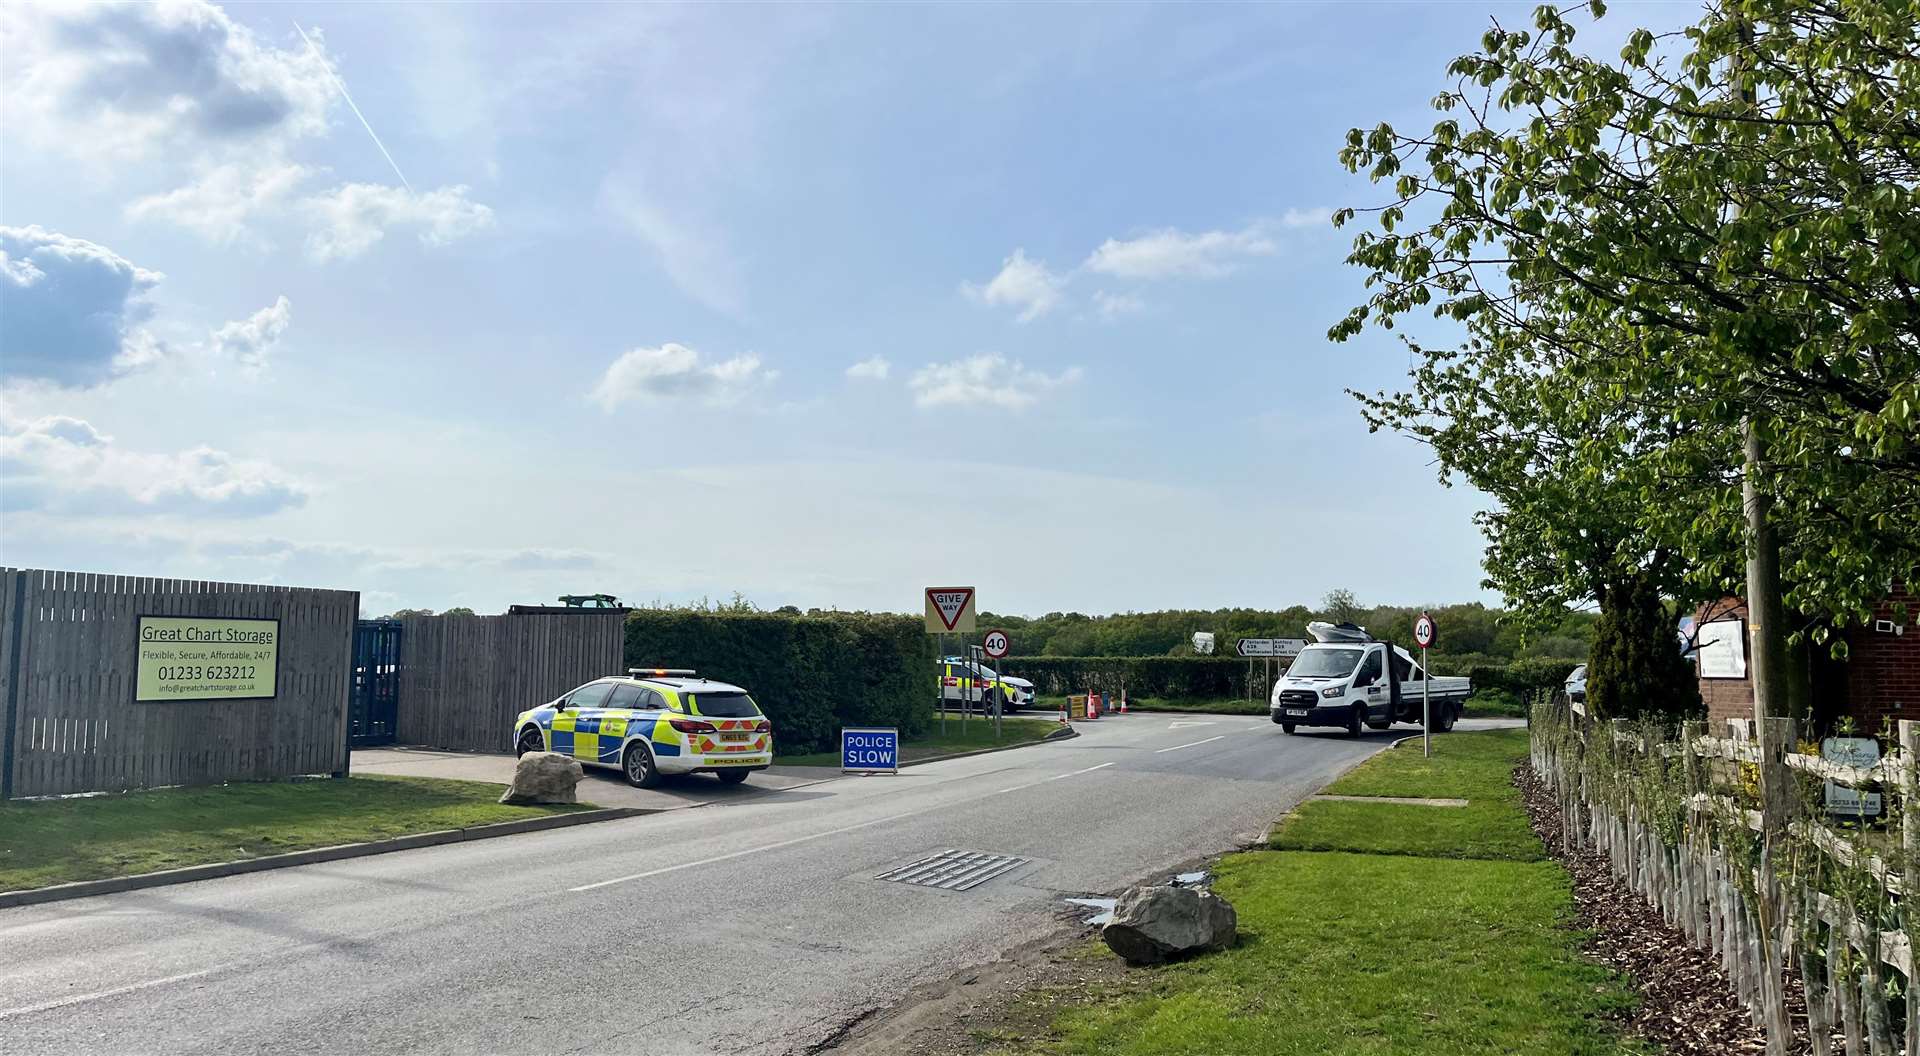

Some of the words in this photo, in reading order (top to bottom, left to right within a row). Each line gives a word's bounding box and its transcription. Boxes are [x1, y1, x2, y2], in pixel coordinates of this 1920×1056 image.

[937, 595, 961, 603] GIVE
[142, 626, 182, 640] Great
[186, 627, 222, 641] Chart
[226, 628, 273, 644] Storage
[1417, 625, 1430, 638] 40
[987, 638, 1005, 650] 40
[142, 650, 177, 660] Flexible,
[179, 651, 208, 660] Secure,
[210, 651, 252, 660] Affordable,
[254, 651, 271, 660] 24/7
[158, 666, 202, 680] 01233
[206, 666, 255, 679] 623212
[158, 683, 255, 693] info@greatchartstorage.co.uk
[847, 736, 892, 748] POLICE
[848, 751, 892, 763] SLOW
